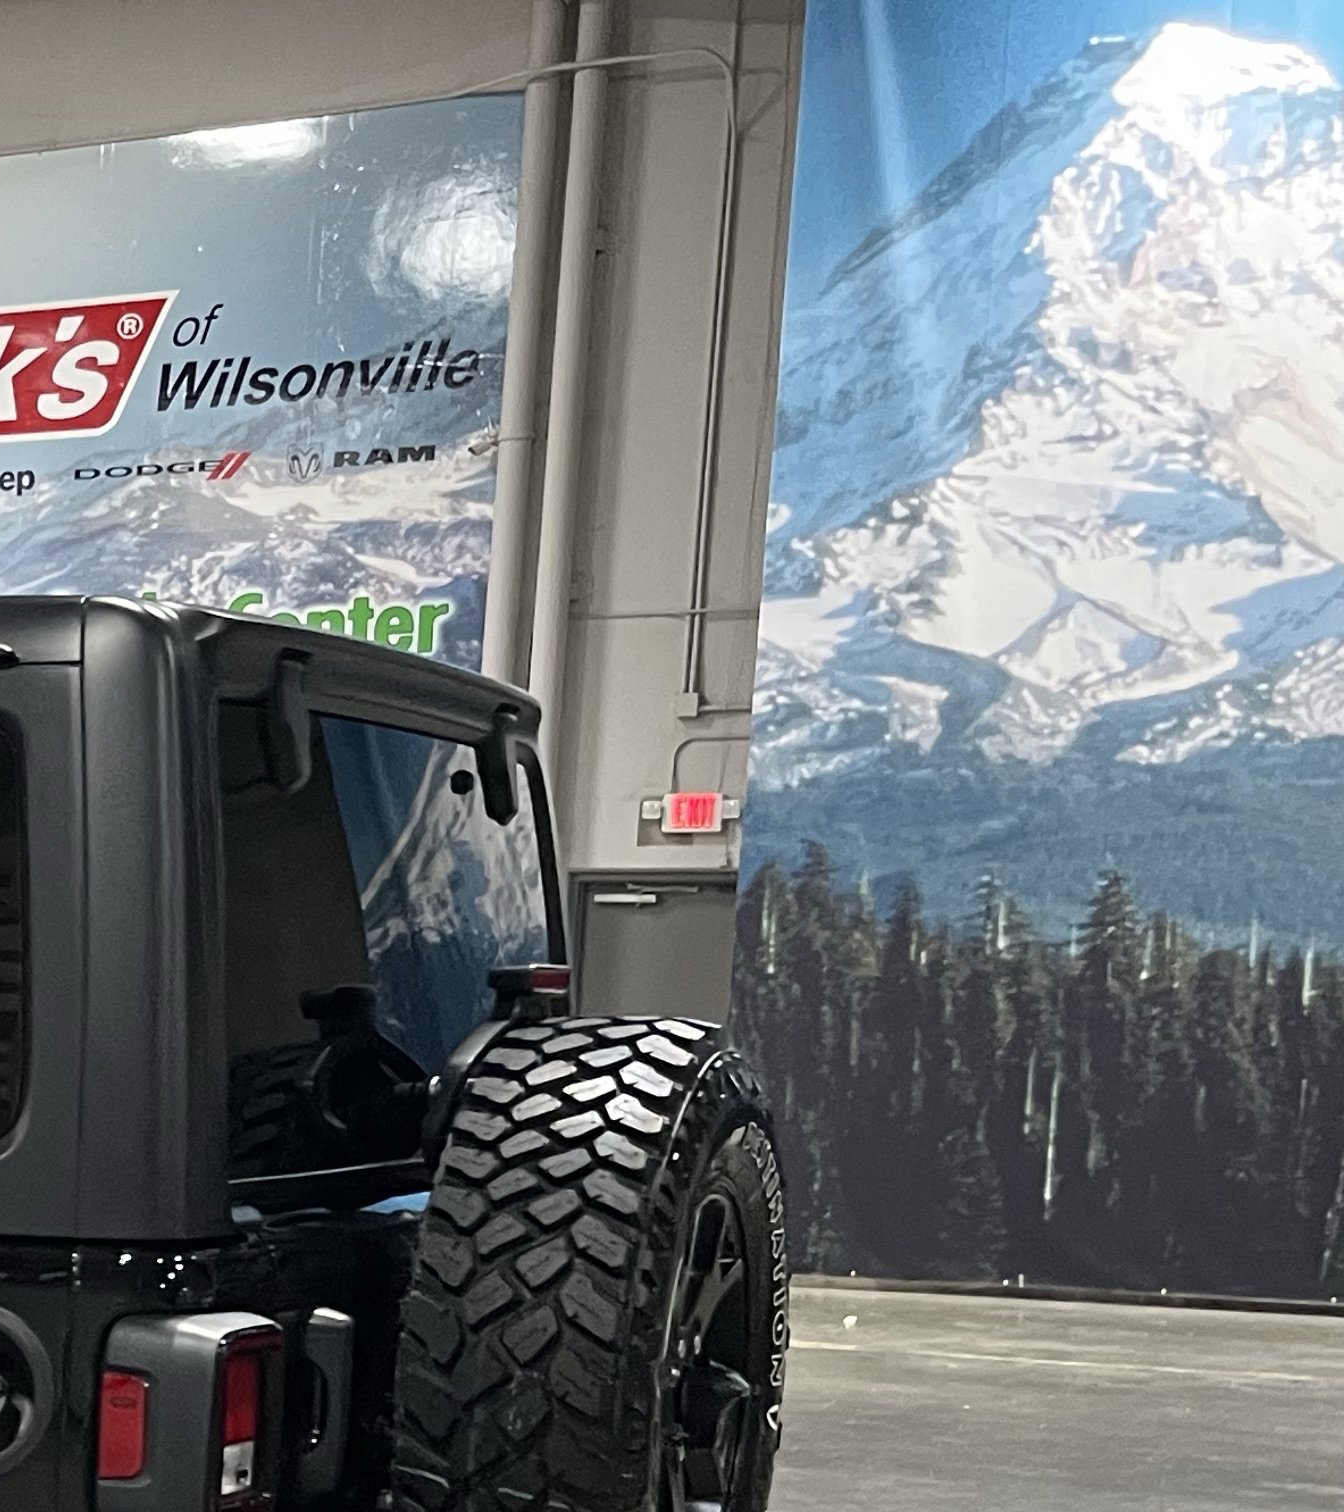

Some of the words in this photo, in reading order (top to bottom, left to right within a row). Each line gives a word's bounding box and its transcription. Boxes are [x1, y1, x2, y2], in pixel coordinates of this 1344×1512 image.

[172, 304, 224, 346] of
[157, 338, 480, 412] Wilsonville
[74, 459, 223, 481] DODGE
[333, 445, 436, 468] RAM
[671, 798, 716, 828] EXIT
